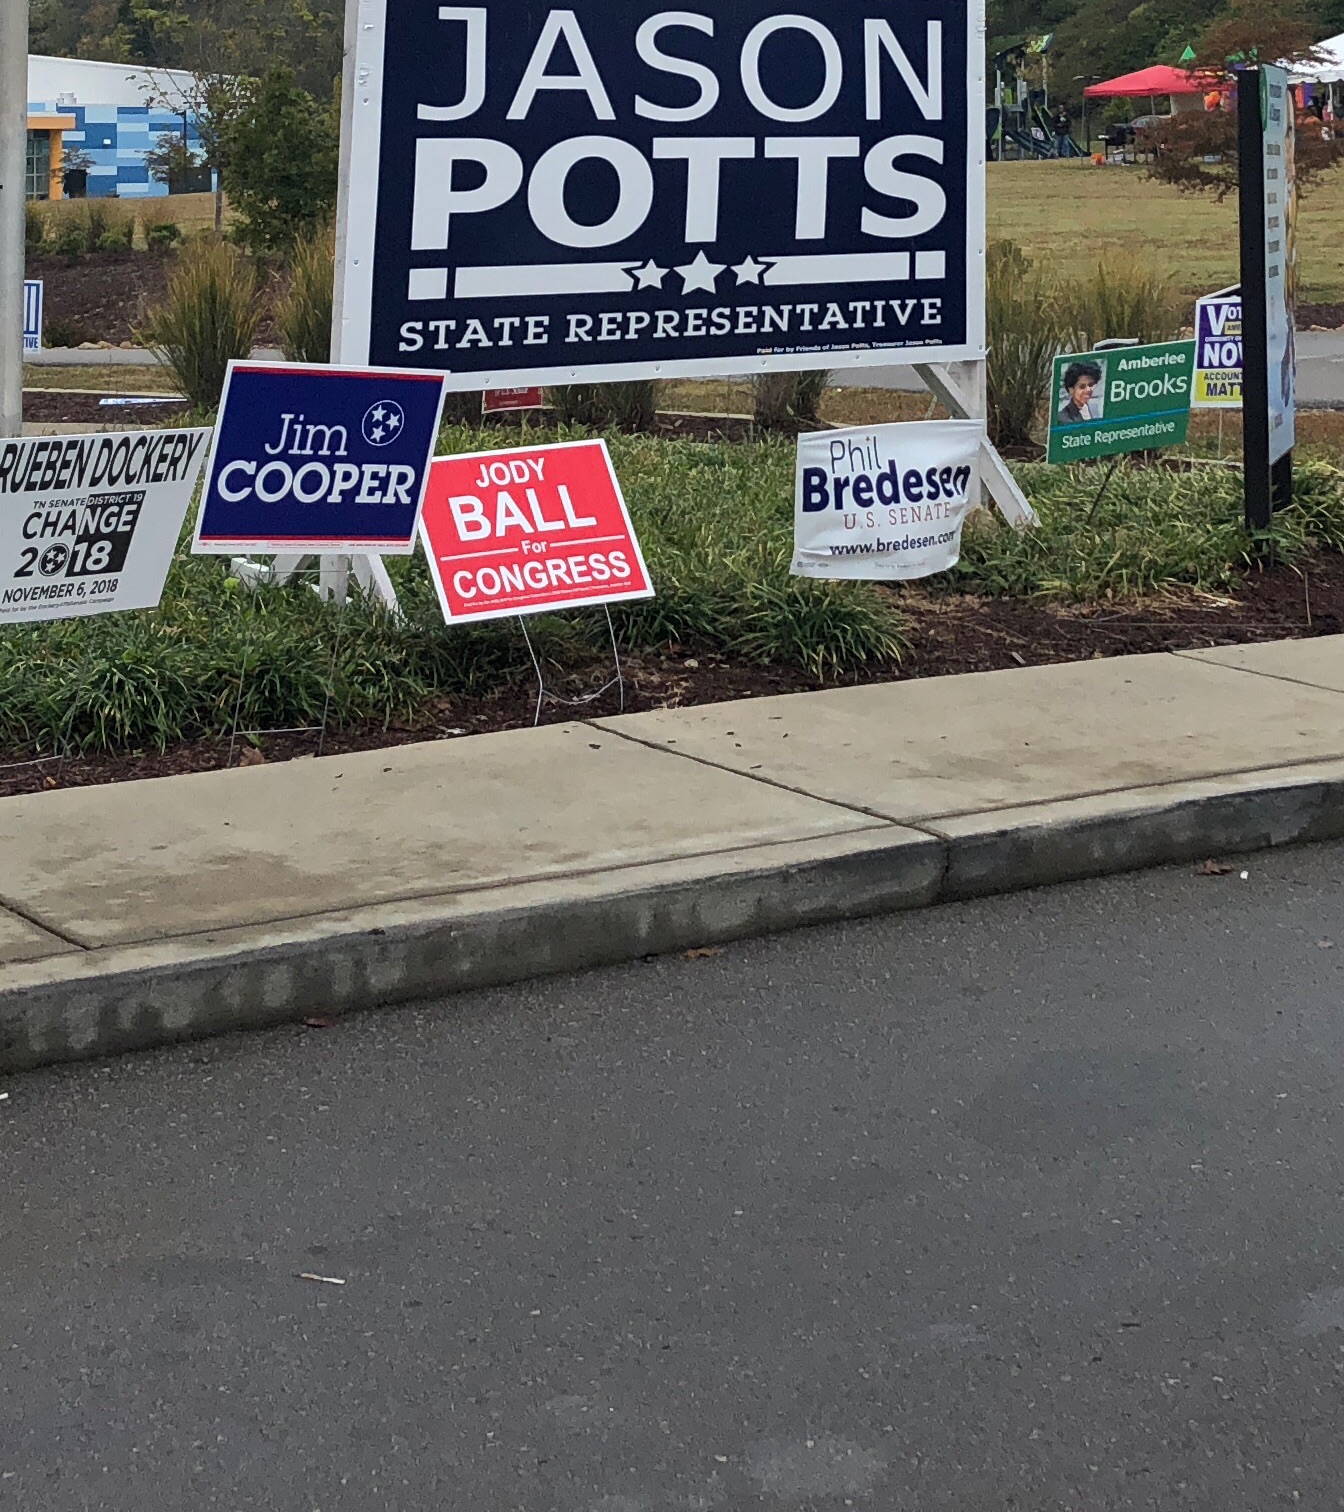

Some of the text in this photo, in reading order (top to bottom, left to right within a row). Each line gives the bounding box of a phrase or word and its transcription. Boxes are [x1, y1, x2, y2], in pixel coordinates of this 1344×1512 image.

[416, 6, 942, 122] JASON
[409, 134, 946, 251] POTTS
[398, 297, 942, 352] STATE REPRESENTATIVE
[1206, 304, 1242, 336] VOT
[1117, 352, 1186, 371] Amberlee
[1110, 373, 1188, 403] Brooks
[1205, 382, 1243, 397] MATT
[264, 414, 348, 456] Jim
[1062, 420, 1175, 449] State Representative
[88, 432, 205, 488] DOCKERY
[829, 436, 882, 474] Phil
[218, 460, 416, 504] COOPER
[475, 457, 545, 489] JODY
[802, 459, 971, 513] Bredesen
[33, 493, 144, 510] TN SENATE DISTRICT 19
[448, 484, 597, 541] BALL
[843, 501, 951, 530] U.S. SENATE
[22, 504, 138, 539] CHANGE
[521, 540, 547, 555] For
[1, 578, 119, 604] NOVEMBER 6, 2018
[453, 550, 631, 599] CONGRESS
